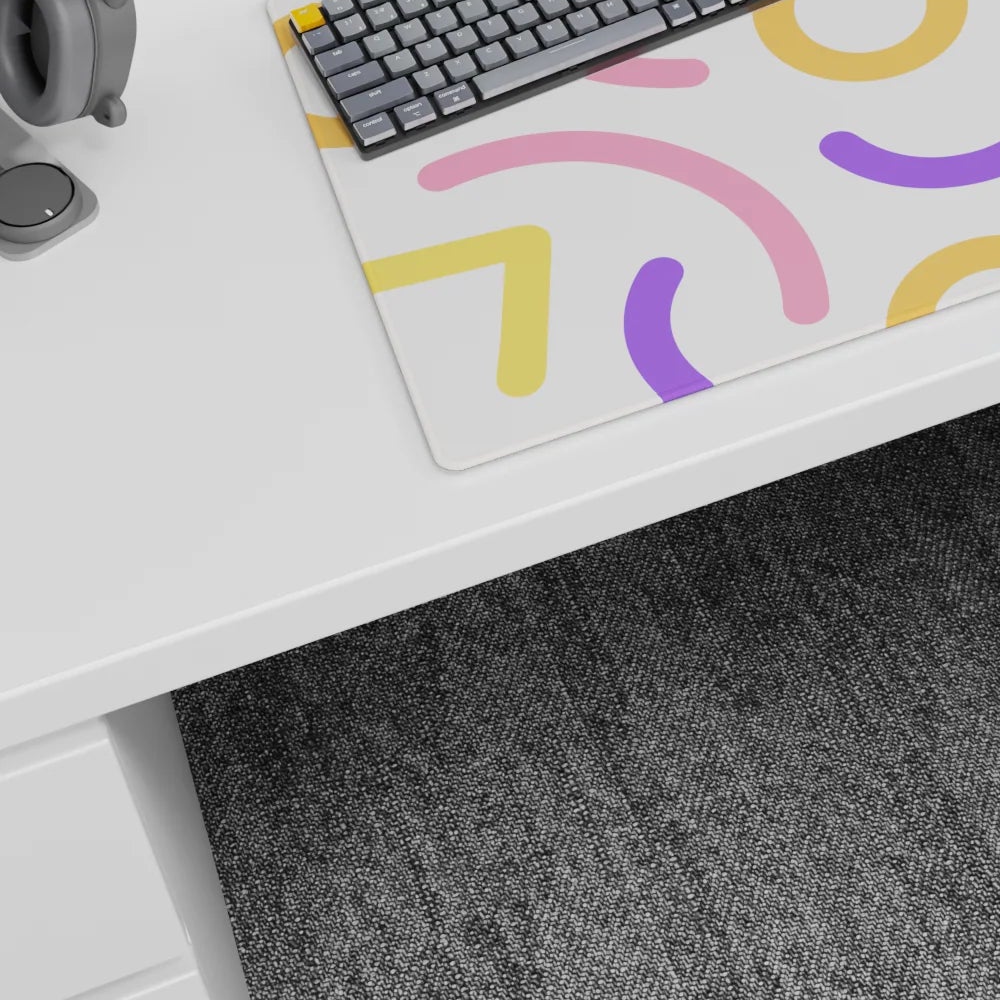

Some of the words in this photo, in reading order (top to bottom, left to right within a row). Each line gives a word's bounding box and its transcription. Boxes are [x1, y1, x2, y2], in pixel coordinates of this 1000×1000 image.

[332, 48, 343, 57] tab
[368, 88, 382, 98] shift
[438, 84, 466, 99] command
[403, 102, 422, 113] option
[362, 117, 383, 128] control
